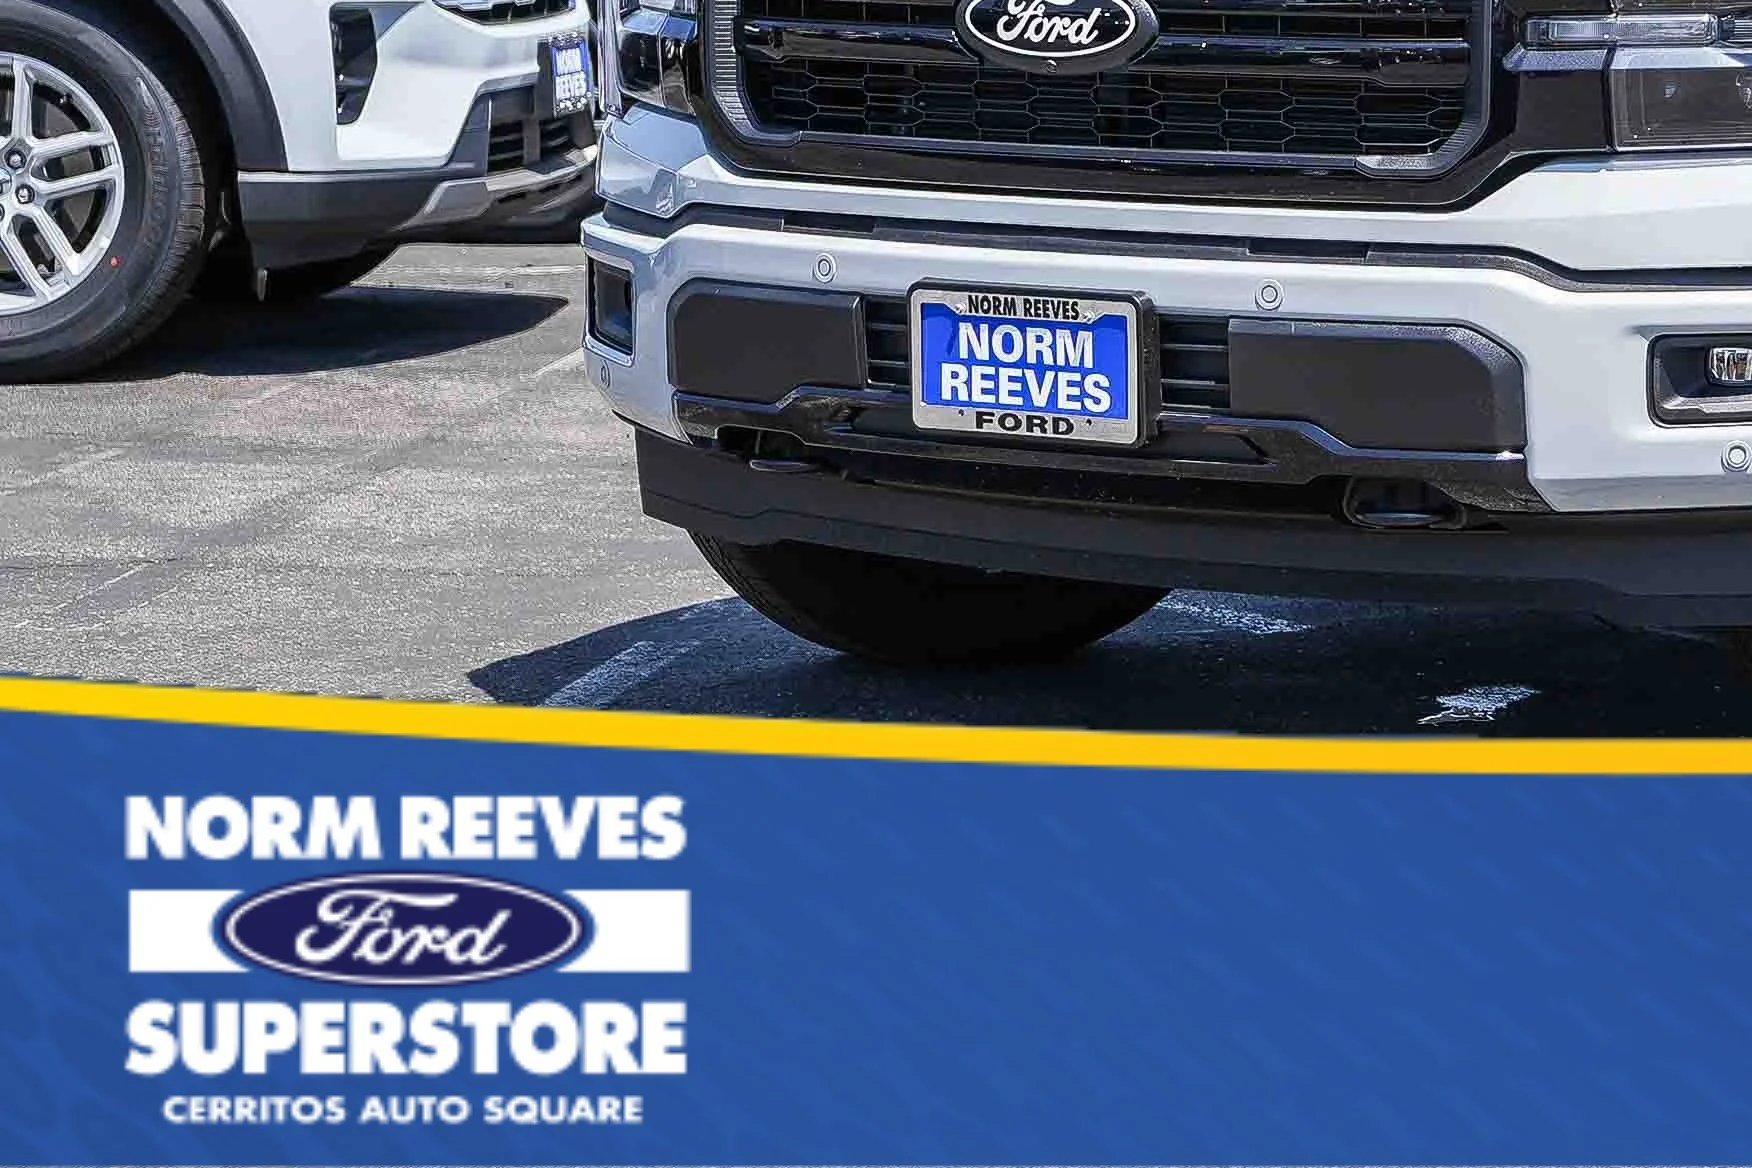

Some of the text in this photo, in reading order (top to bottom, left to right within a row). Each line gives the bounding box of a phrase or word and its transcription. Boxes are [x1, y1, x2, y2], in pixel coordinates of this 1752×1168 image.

[968, 295, 1080, 321] NORM REEVES
[958, 322, 1094, 369] NORM
[940, 362, 1111, 413] REEVES
[975, 411, 1075, 436] FORD
